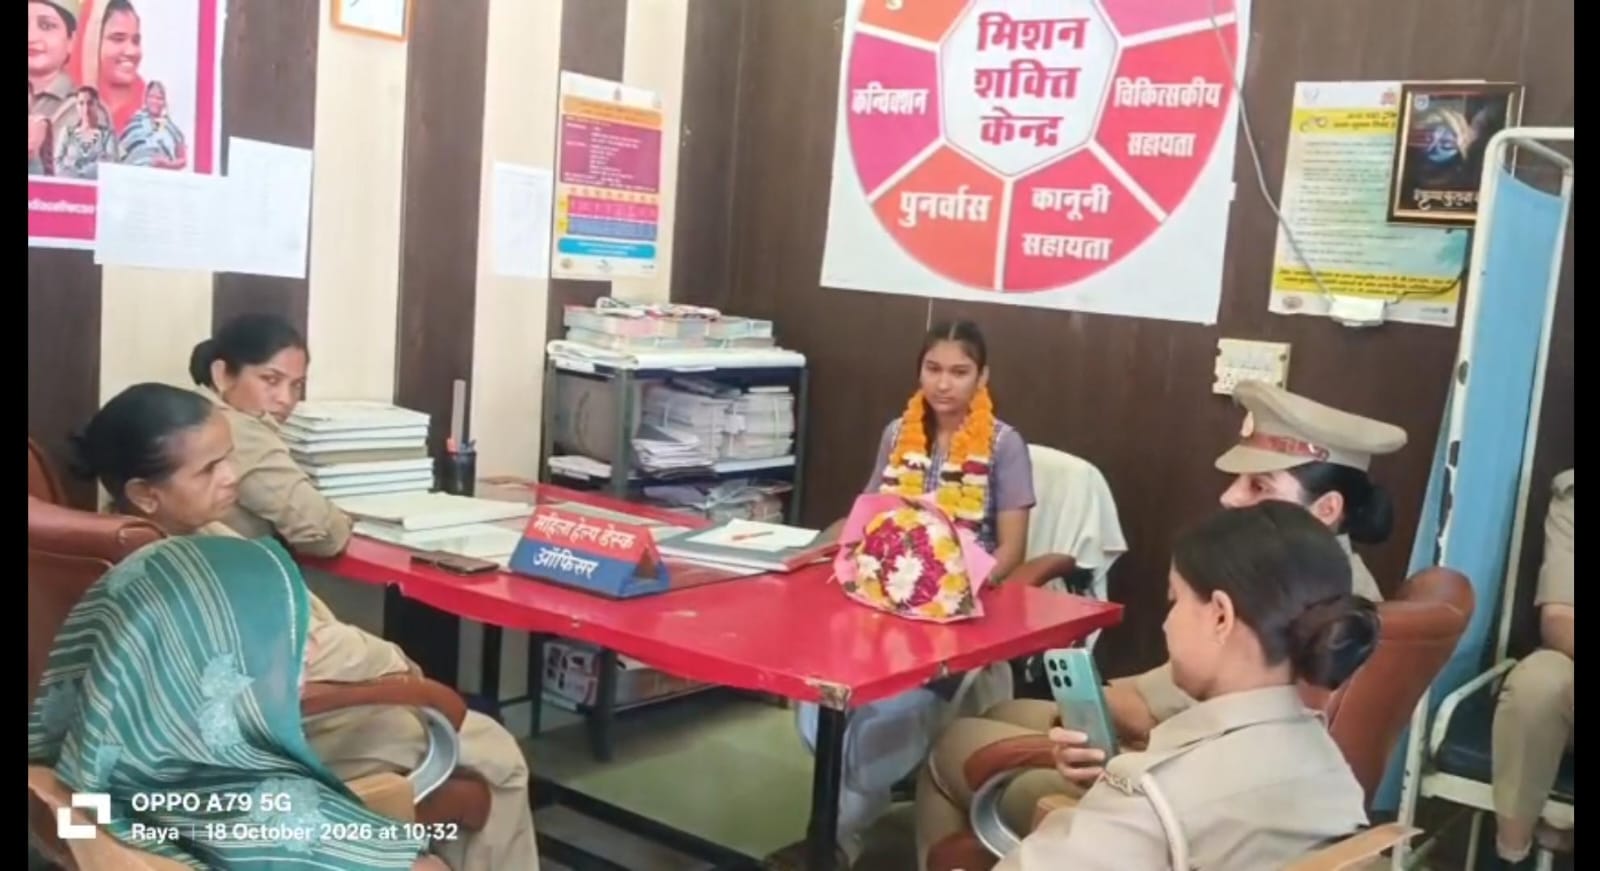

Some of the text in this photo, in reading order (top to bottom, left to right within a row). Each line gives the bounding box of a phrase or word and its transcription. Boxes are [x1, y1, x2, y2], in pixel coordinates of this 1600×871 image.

[977, 11, 1091, 51] मिशन
[974, 58, 1083, 98] शक्ति
[1113, 76, 1225, 108] चिकित्सकीय
[851, 80, 931, 115] कन्विक्शन
[979, 105, 1065, 147] केन्द्र
[1127, 131, 1198, 157] सहायता
[898, 185, 993, 228] पुनर्वास
[1031, 183, 1112, 221] कानूनी
[1022, 233, 1113, 261] सहायता
[534, 512, 575, 539] महिला
[533, 547, 598, 578] ऑफिसर
